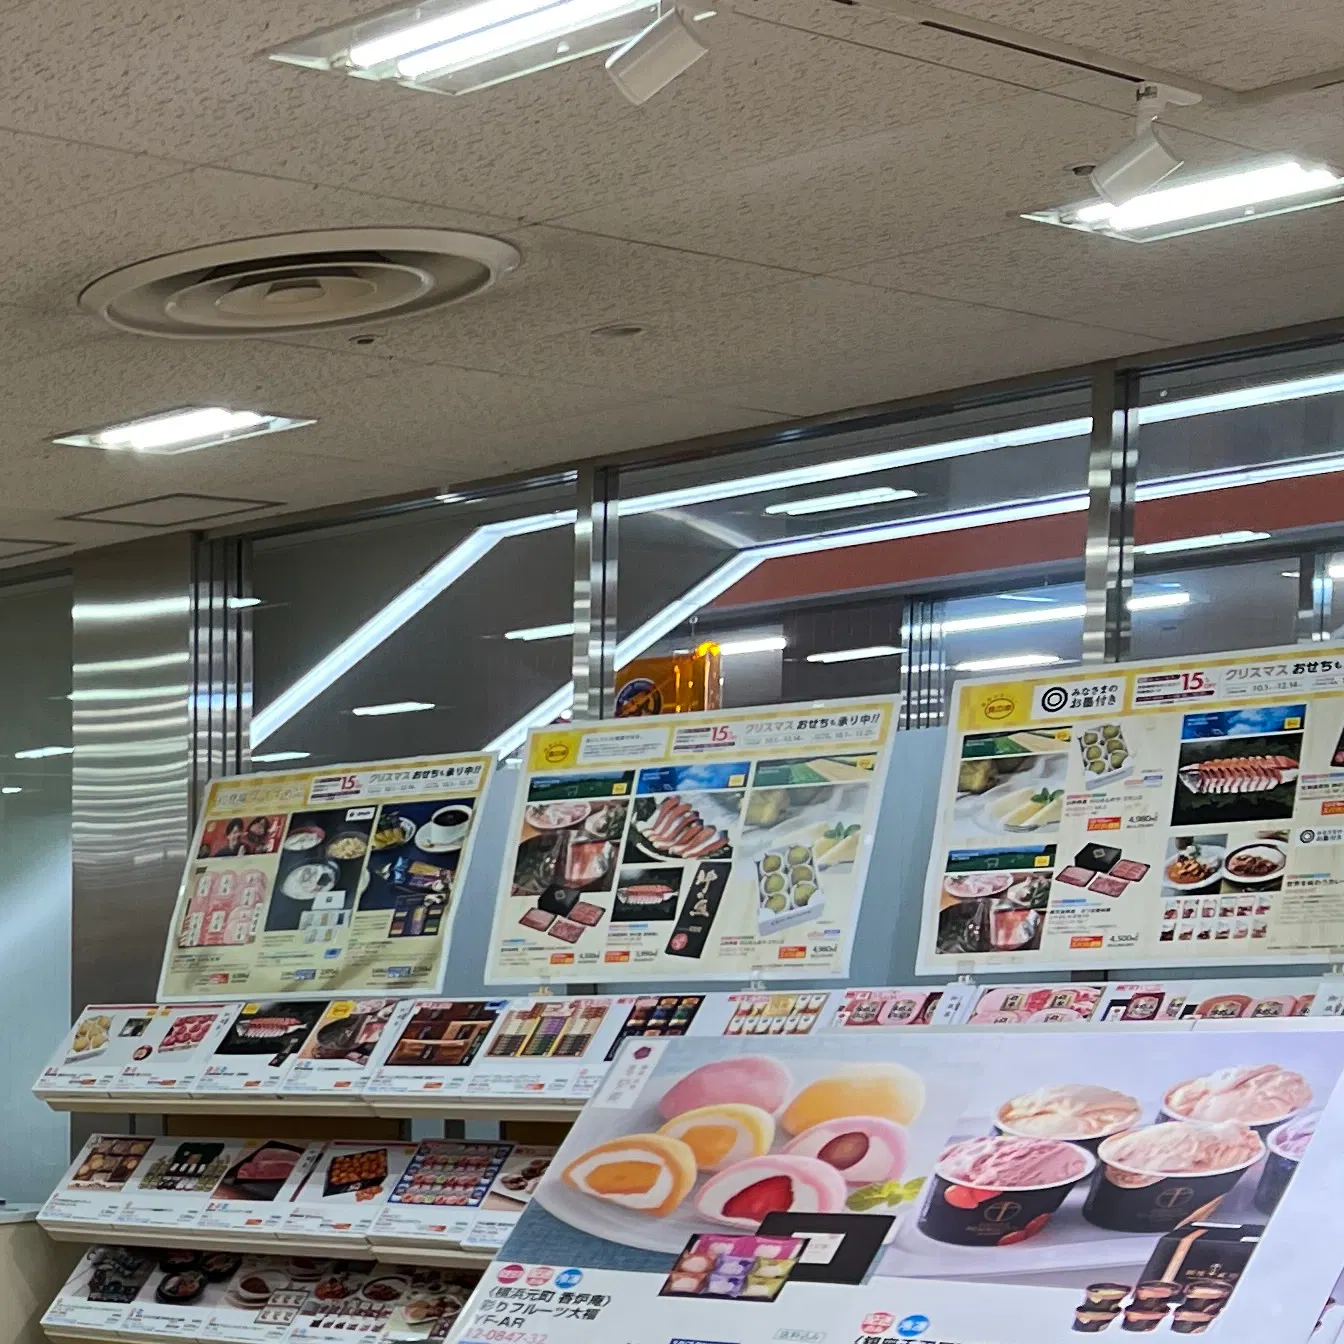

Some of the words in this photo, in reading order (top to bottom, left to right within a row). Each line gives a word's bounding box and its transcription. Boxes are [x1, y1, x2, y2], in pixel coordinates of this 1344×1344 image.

[1224, 664, 1289, 681] クリスマス
[1070, 684, 1119, 697] みなさまの
[1180, 672, 1205, 692] 15
[711, 725, 729, 742] 15
[745, 720, 795, 733] クリスマス
[479, 1300, 600, 1321] 彩りフルーツ大福
[474, 1314, 526, 1330] YF-AR
